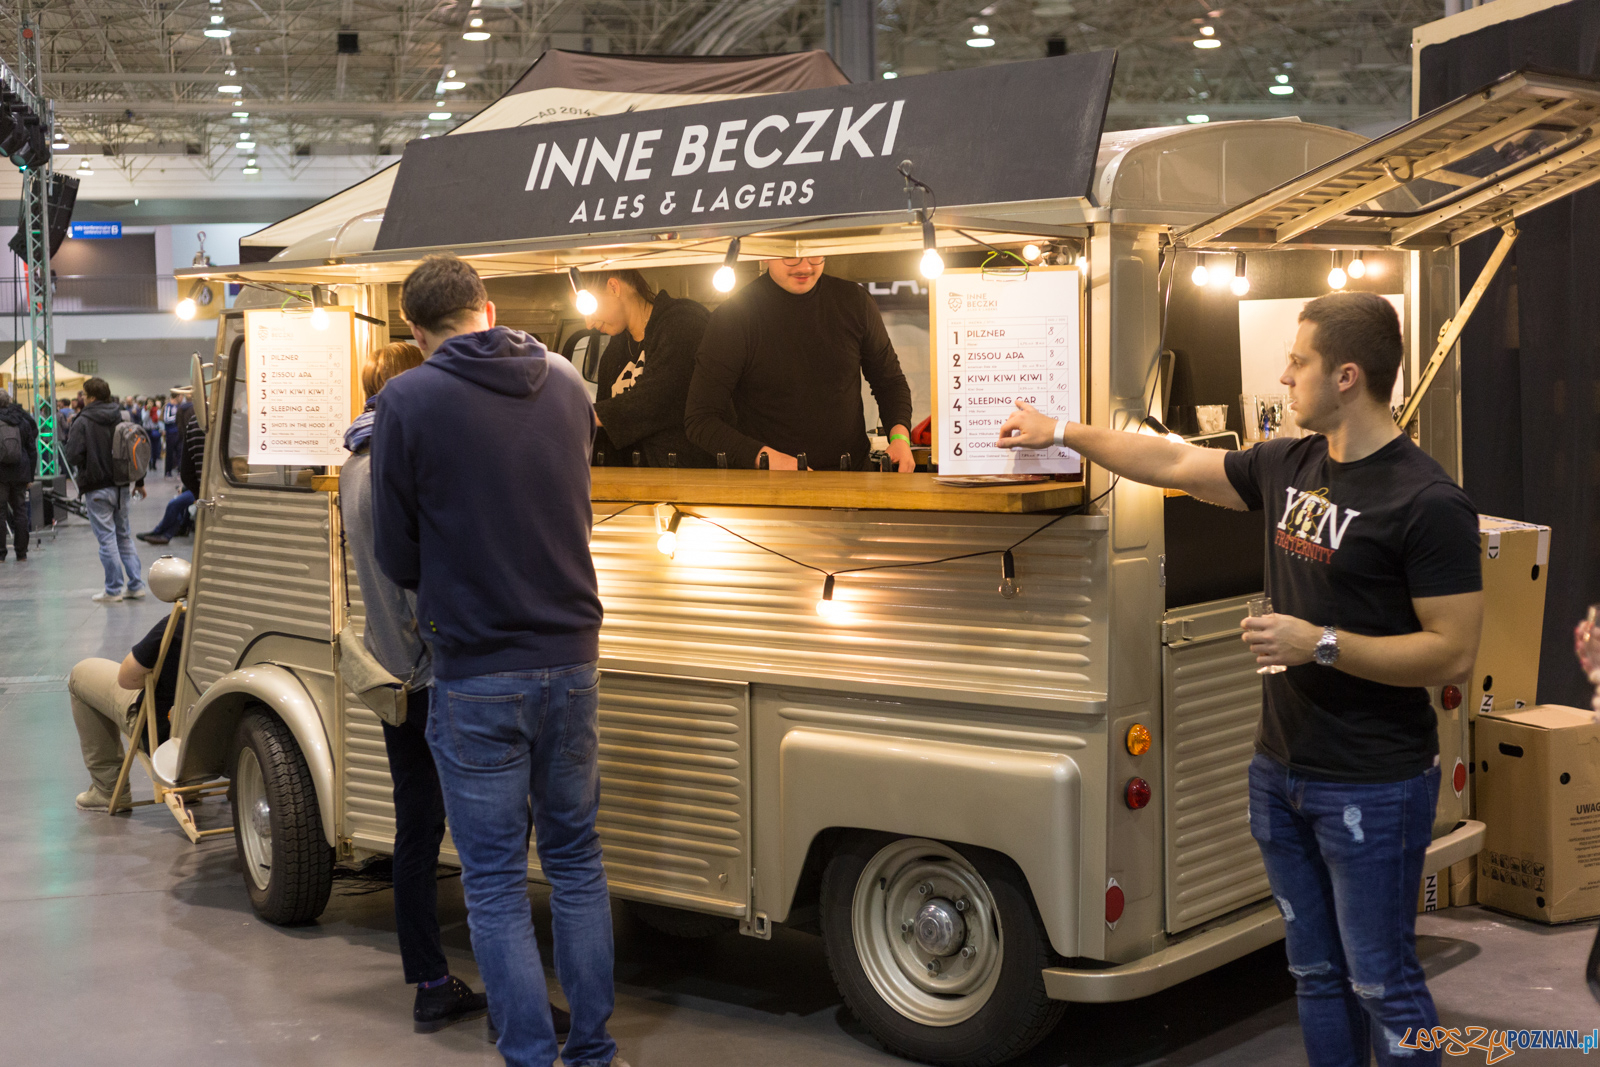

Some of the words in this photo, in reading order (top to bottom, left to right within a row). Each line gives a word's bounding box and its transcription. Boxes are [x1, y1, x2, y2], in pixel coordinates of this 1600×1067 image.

[538, 107, 557, 118] AD
[560, 106, 591, 117] 2014
[524, 129, 663, 191] INNE
[671, 100, 905, 177] BECZKI
[569, 193, 645, 224] ALES
[659, 190, 676, 216] &
[691, 178, 815, 214] LAGERS
[967, 300, 998, 308] BECZKI
[953, 331, 959, 344] 1
[967, 330, 1006, 338] PILZNER
[261, 354, 265, 366] 1
[953, 353, 961, 367] 2
[967, 352, 1001, 360] ZISSOU
[1005, 351, 1025, 359] APA
[260, 372, 267, 383] 2
[953, 376, 962, 390] 3
[993, 374, 1016, 382] KIWI
[1020, 373, 1042, 381] KIWI
[261, 389, 267, 400] 3
[953, 398, 962, 412] 4
[968, 397, 1012, 405] SLEEPING
[260, 406, 267, 417] 4
[261, 423, 267, 434] 5
[954, 420, 962, 434] 5
[260, 440, 267, 451] 6
[953, 443, 963, 456] 6
[1274, 530, 1336, 564] FRATERNITY
